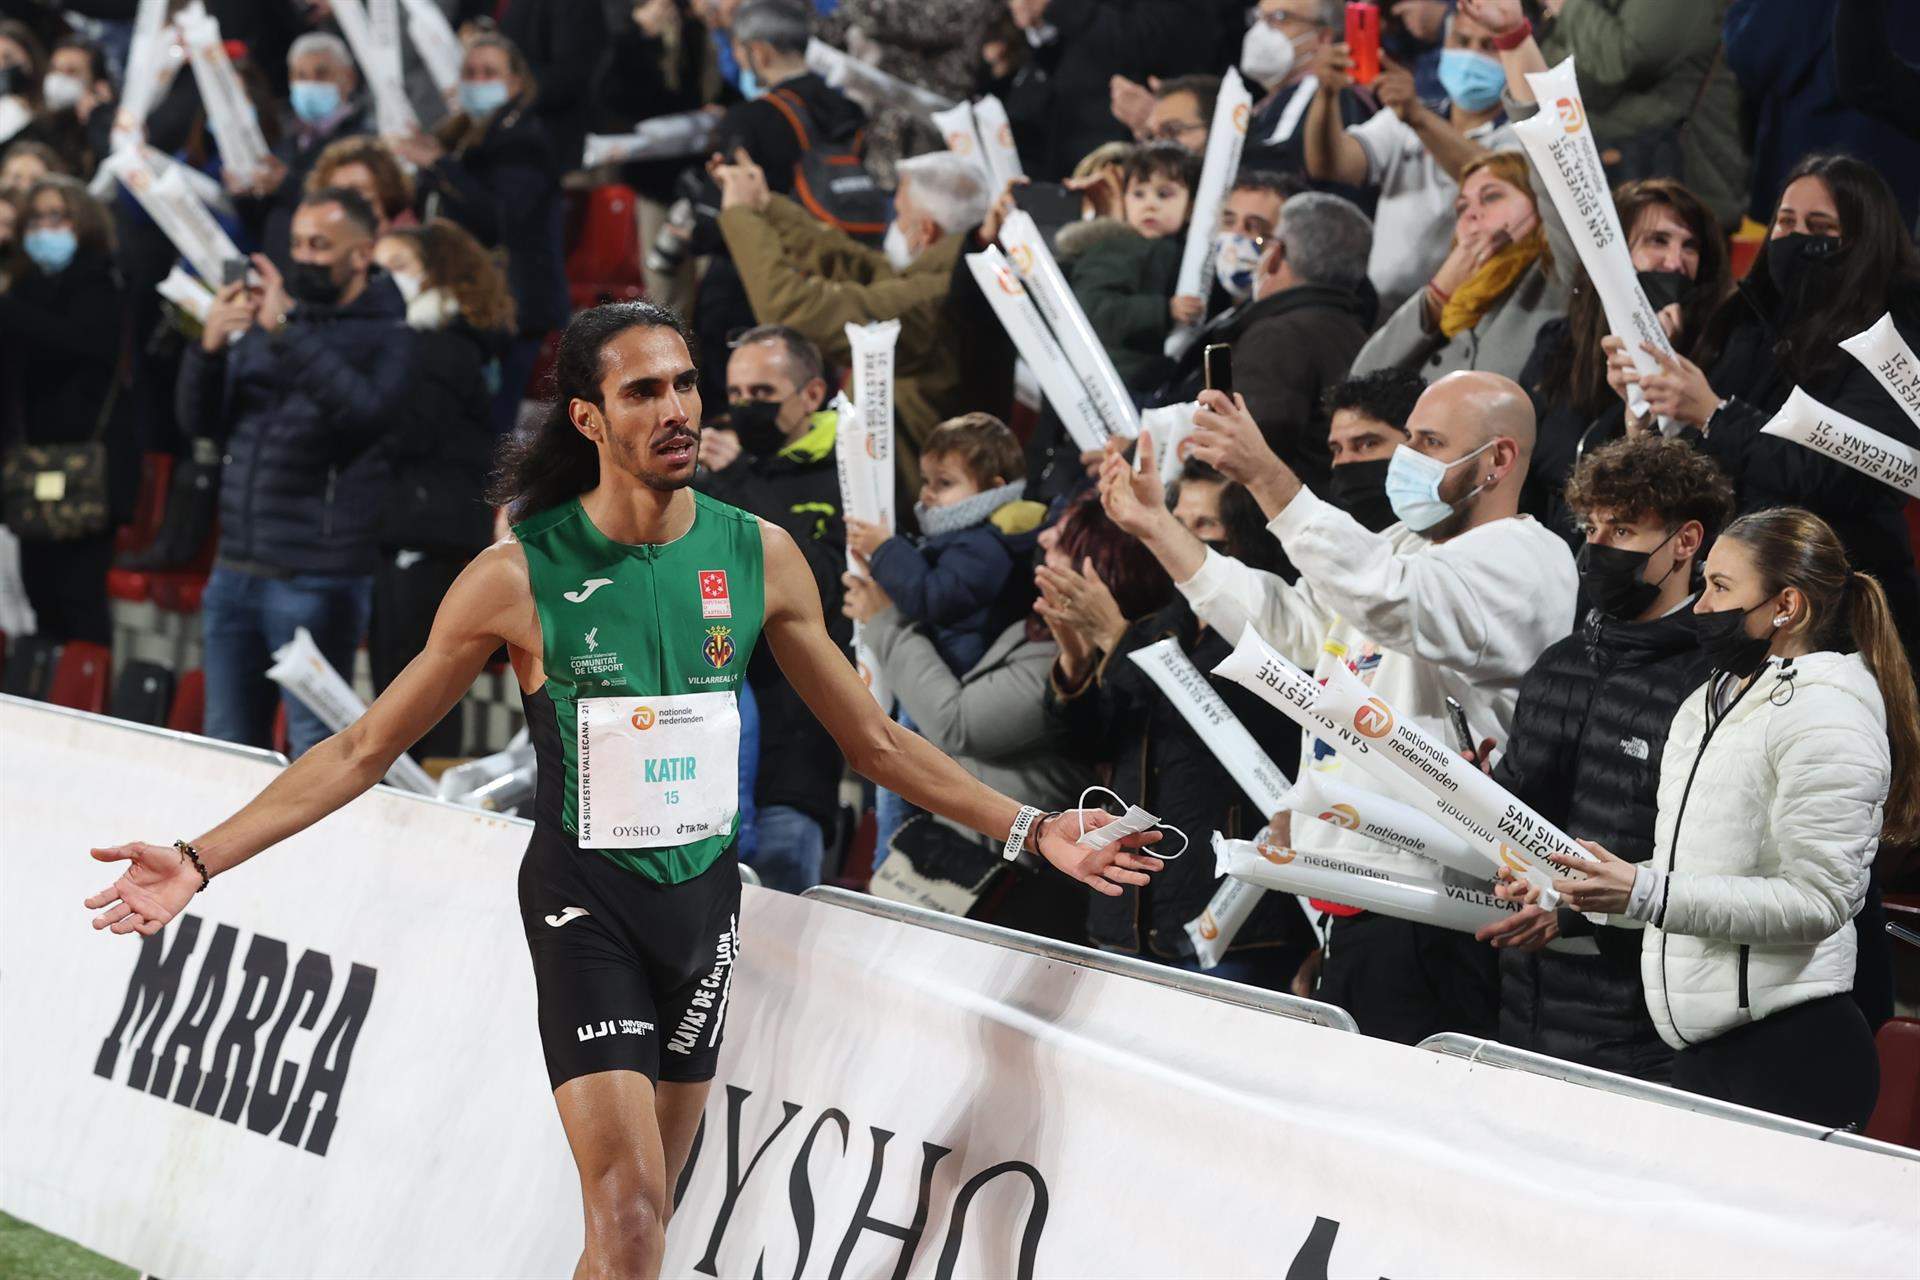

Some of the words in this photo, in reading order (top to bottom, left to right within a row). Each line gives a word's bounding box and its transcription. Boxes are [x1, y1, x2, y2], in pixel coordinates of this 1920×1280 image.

[1549, 140, 1594, 216] SILVESTRE
[1586, 217, 1609, 249] SAN
[1891, 352, 1909, 372] 21
[1815, 420, 1834, 436] 21
[1804, 431, 1883, 475] SILVESTRE
[1842, 431, 1918, 480] VALLECANA
[1880, 468, 1914, 489] SAN
[571, 656, 617, 668] COMUNITAT
[575, 667, 586, 675] DE
[587, 663, 624, 674] L'ESPORT
[688, 675, 731, 684] VILLARREAL
[1160, 651, 1206, 704] SILVESTRE
[581, 705, 589, 714] 21
[659, 707, 693, 717] nationale
[659, 715, 704, 726] nederlanden
[1201, 702, 1224, 726] SAN
[581, 721, 590, 771] VALLECANA
[1397, 724, 1450, 768] nationale
[644, 756, 696, 783] KATIR
[1387, 737, 1459, 793] nederlanden
[582, 772, 591, 820] SILVESTRE
[664, 791, 680, 805] 15
[582, 822, 591, 841] SAN
[612, 825, 661, 837] OYSHO
[1436, 797, 1495, 844] nationale
[1504, 804, 1534, 832] SAN
[1366, 821, 1426, 851] nationale
[1303, 854, 1390, 882] nederlanden
[93, 912, 378, 1157] MARCA
[577, 1020, 617, 1042] UJI
[666, 1008, 708, 1055] PLAYAS
[691, 988, 717, 1009] DE
[673, 1084, 1049, 1280] YSHO
